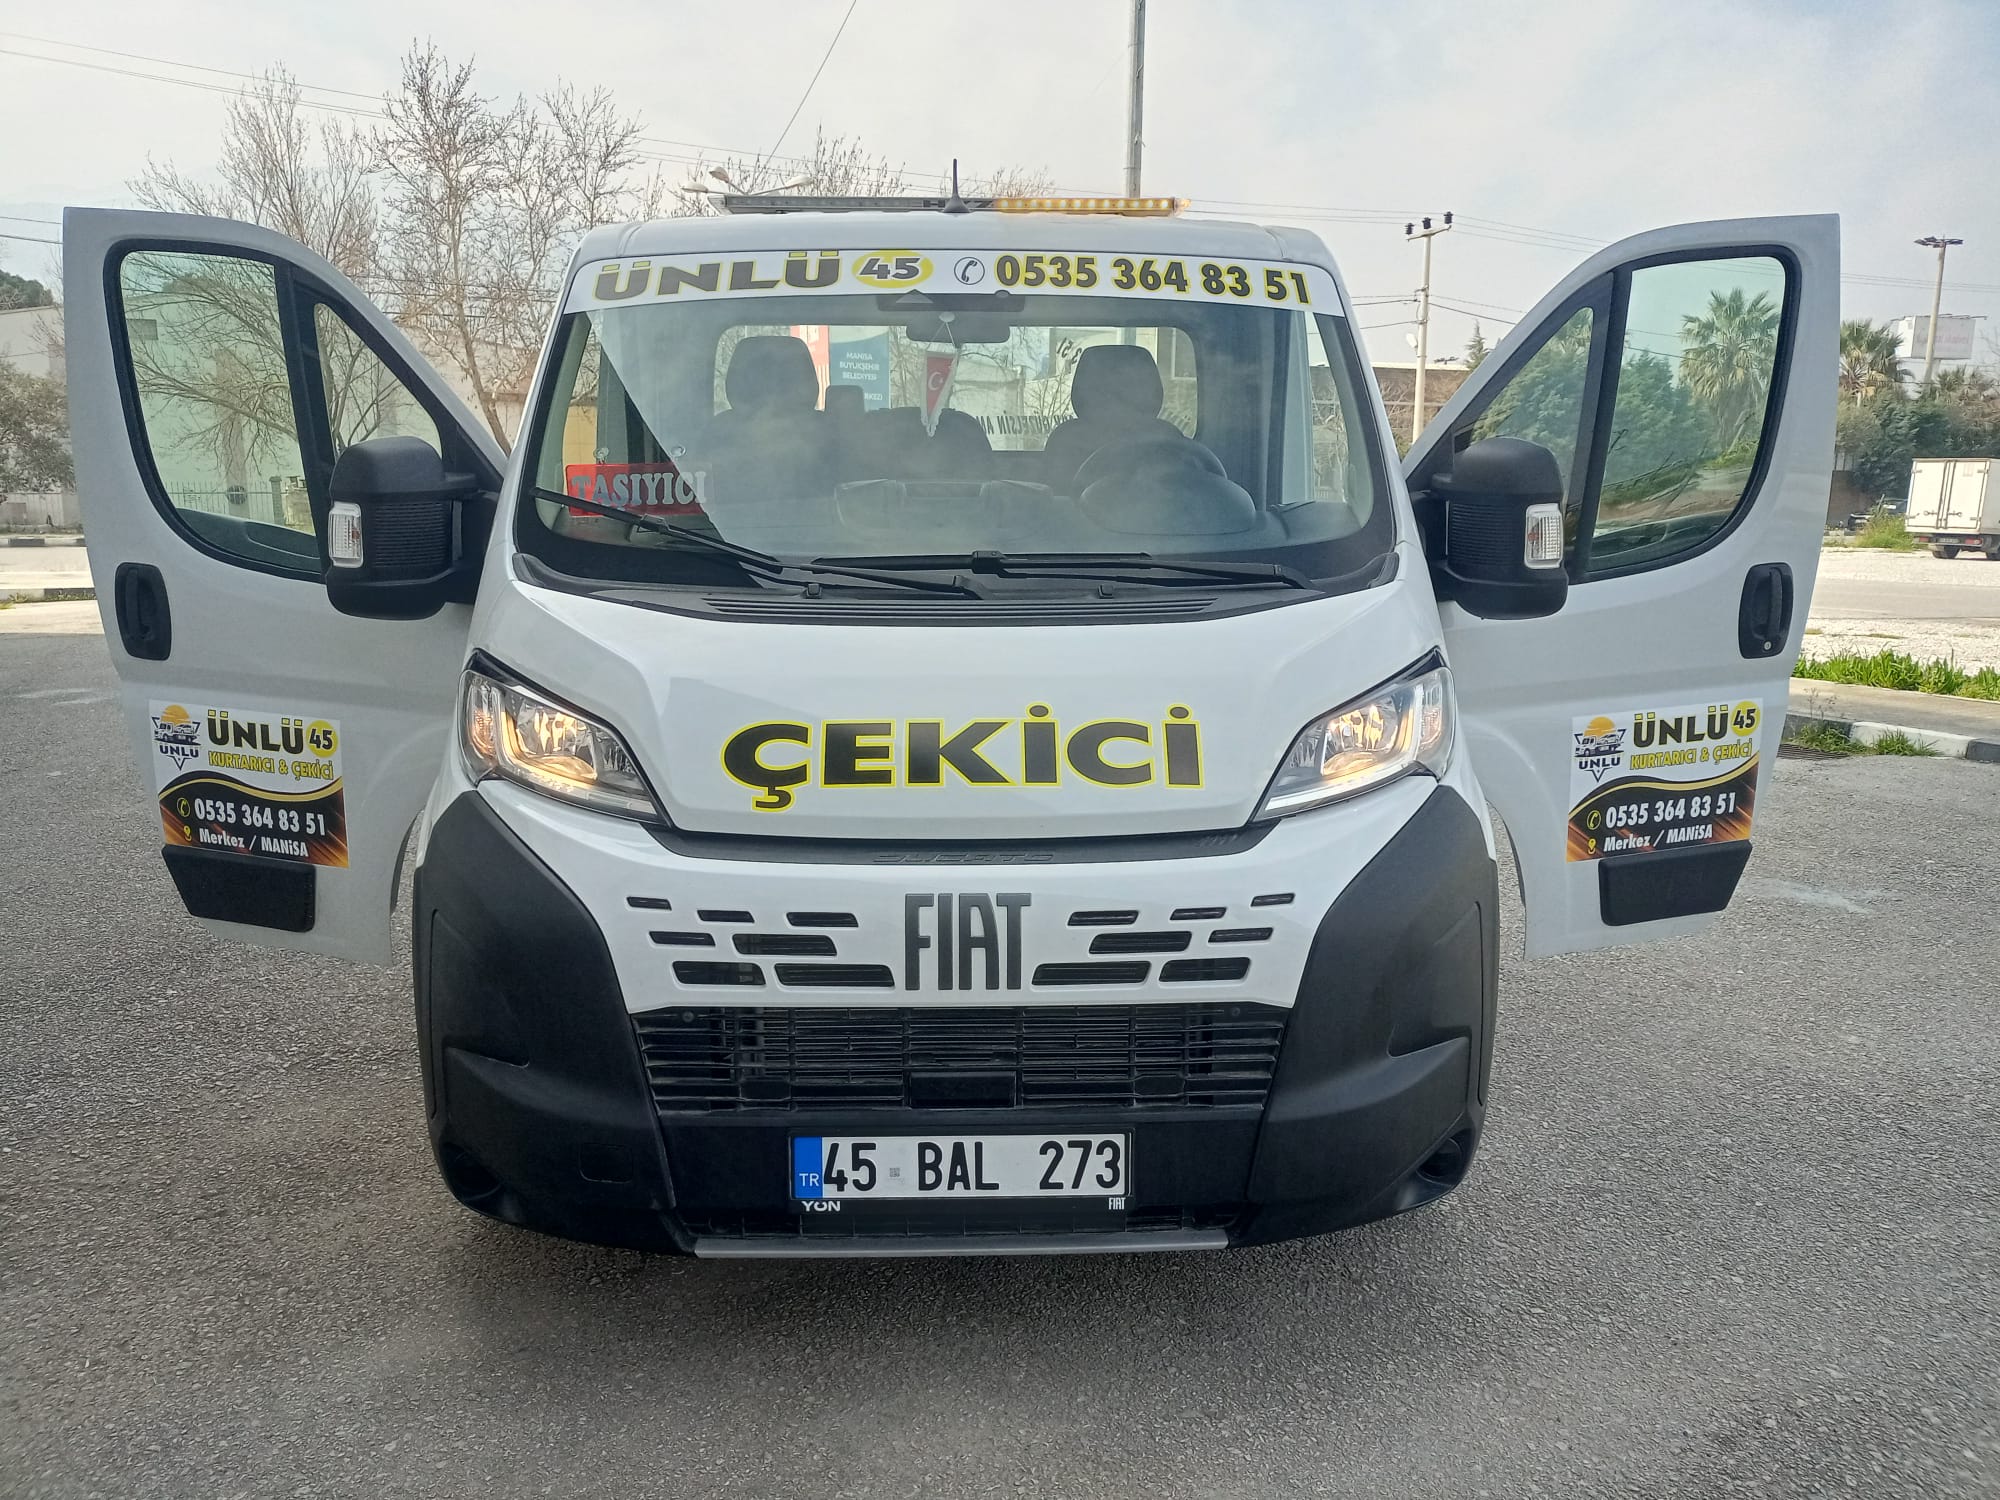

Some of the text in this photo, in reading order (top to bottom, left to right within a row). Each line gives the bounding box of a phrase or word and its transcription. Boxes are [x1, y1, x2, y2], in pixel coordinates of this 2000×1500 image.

[594, 250, 920, 300] ÜNLÜ 45
[996, 255, 1312, 305] 0535 364 83 51
[207, 709, 333, 755] ÜNLÜ 45
[1633, 704, 1756, 748] ÜNLÜ 45
[208, 751, 335, 781] KURTARICI & ÇEKİCİ
[720, 703, 1204, 812] ÇEKİCİ
[1629, 738, 1753, 770] KURTARICI & ÇEKİCİ
[194, 798, 326, 836] 0535 364 83 51
[1605, 792, 1736, 829] 0535 364 83 51
[199, 828, 245, 849] Merkez
[1603, 833, 1651, 852] Merkez
[904, 893, 1032, 991] FIAT
[799, 1140, 1121, 1193] TR 45 BAL 273
[1108, 1197, 1126, 1210] FIAT
